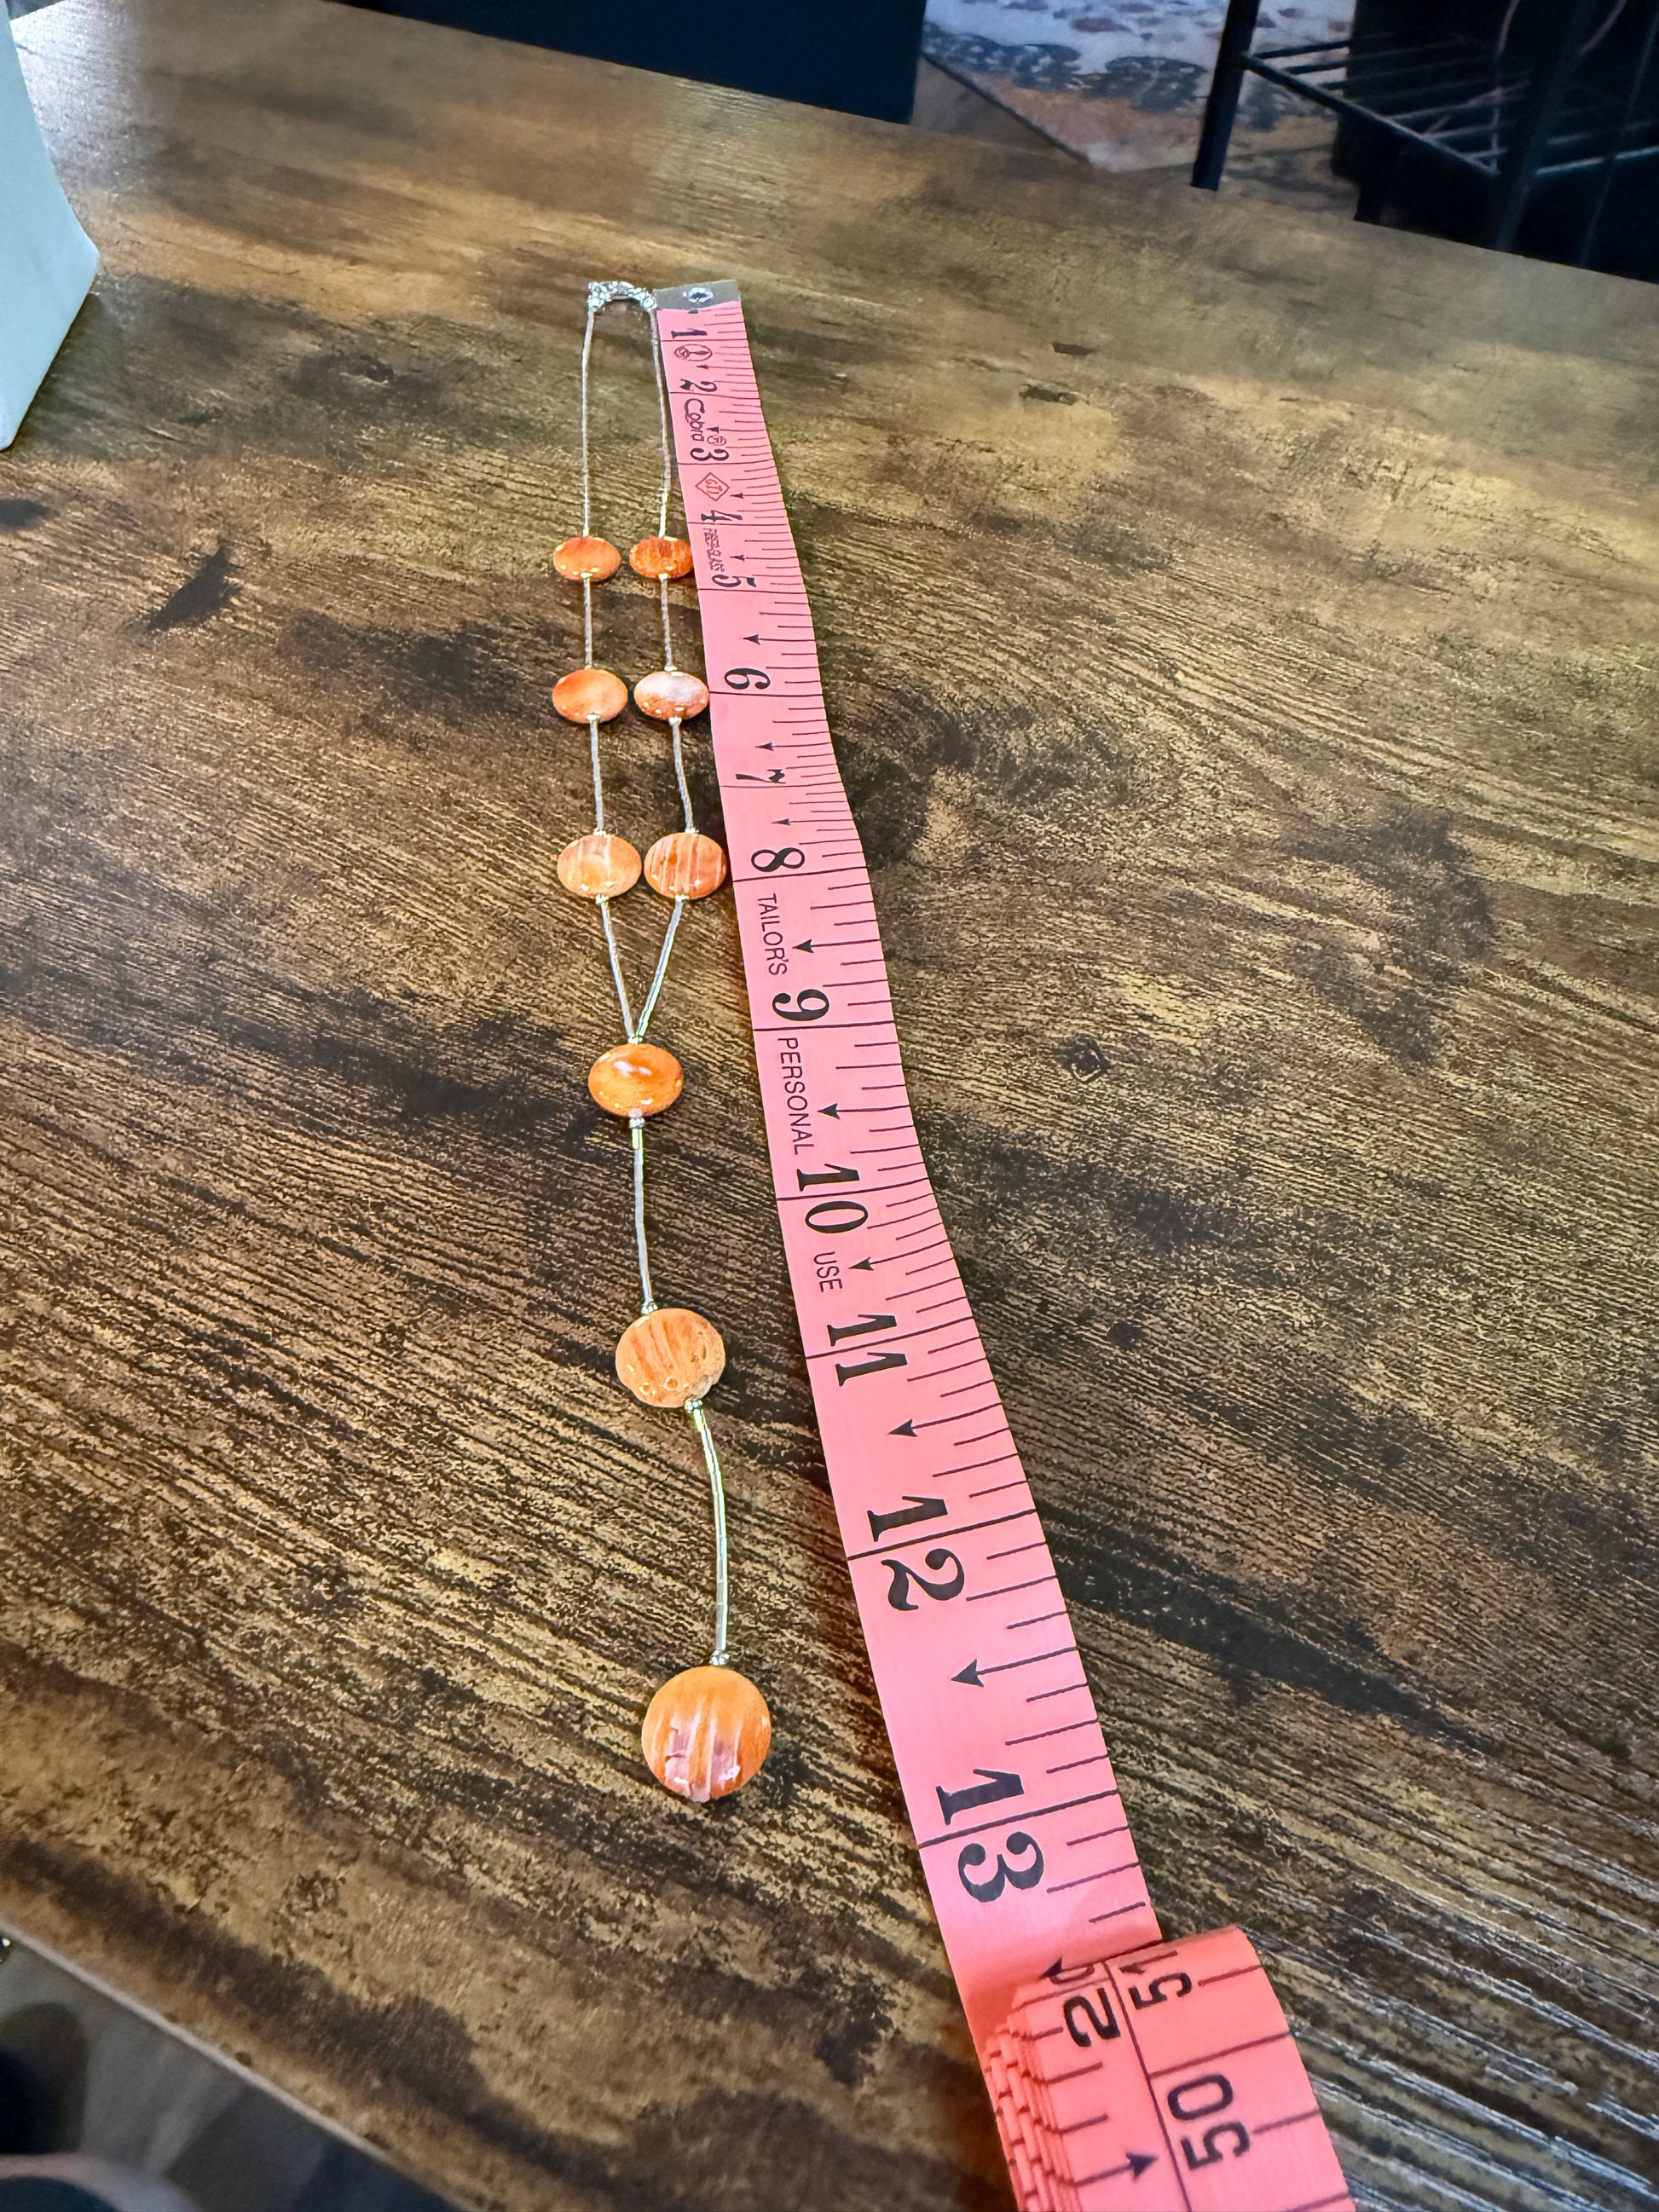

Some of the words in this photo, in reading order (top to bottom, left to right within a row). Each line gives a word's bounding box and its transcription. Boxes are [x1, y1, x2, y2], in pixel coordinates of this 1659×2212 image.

[671, 329, 708, 338] 1
[680, 379, 718, 392] 2
[690, 447, 730, 462] 3
[701, 510, 743, 522] 4
[712, 574, 757, 587] 5
[724, 667, 771, 690] 6
[736, 769, 786, 784] 7
[751, 847, 806, 873] 8
[772, 988, 830, 1021] 9
[777, 1037, 814, 1155] PERSONAL
[796, 1163, 869, 1234] 10
[813, 1250, 843, 1293] USE
[826, 1313, 908, 1387] 11
[867, 1495, 965, 1611] 12
[935, 1768, 1044, 1903] 13
[1167, 2073, 1251, 2171] 50
